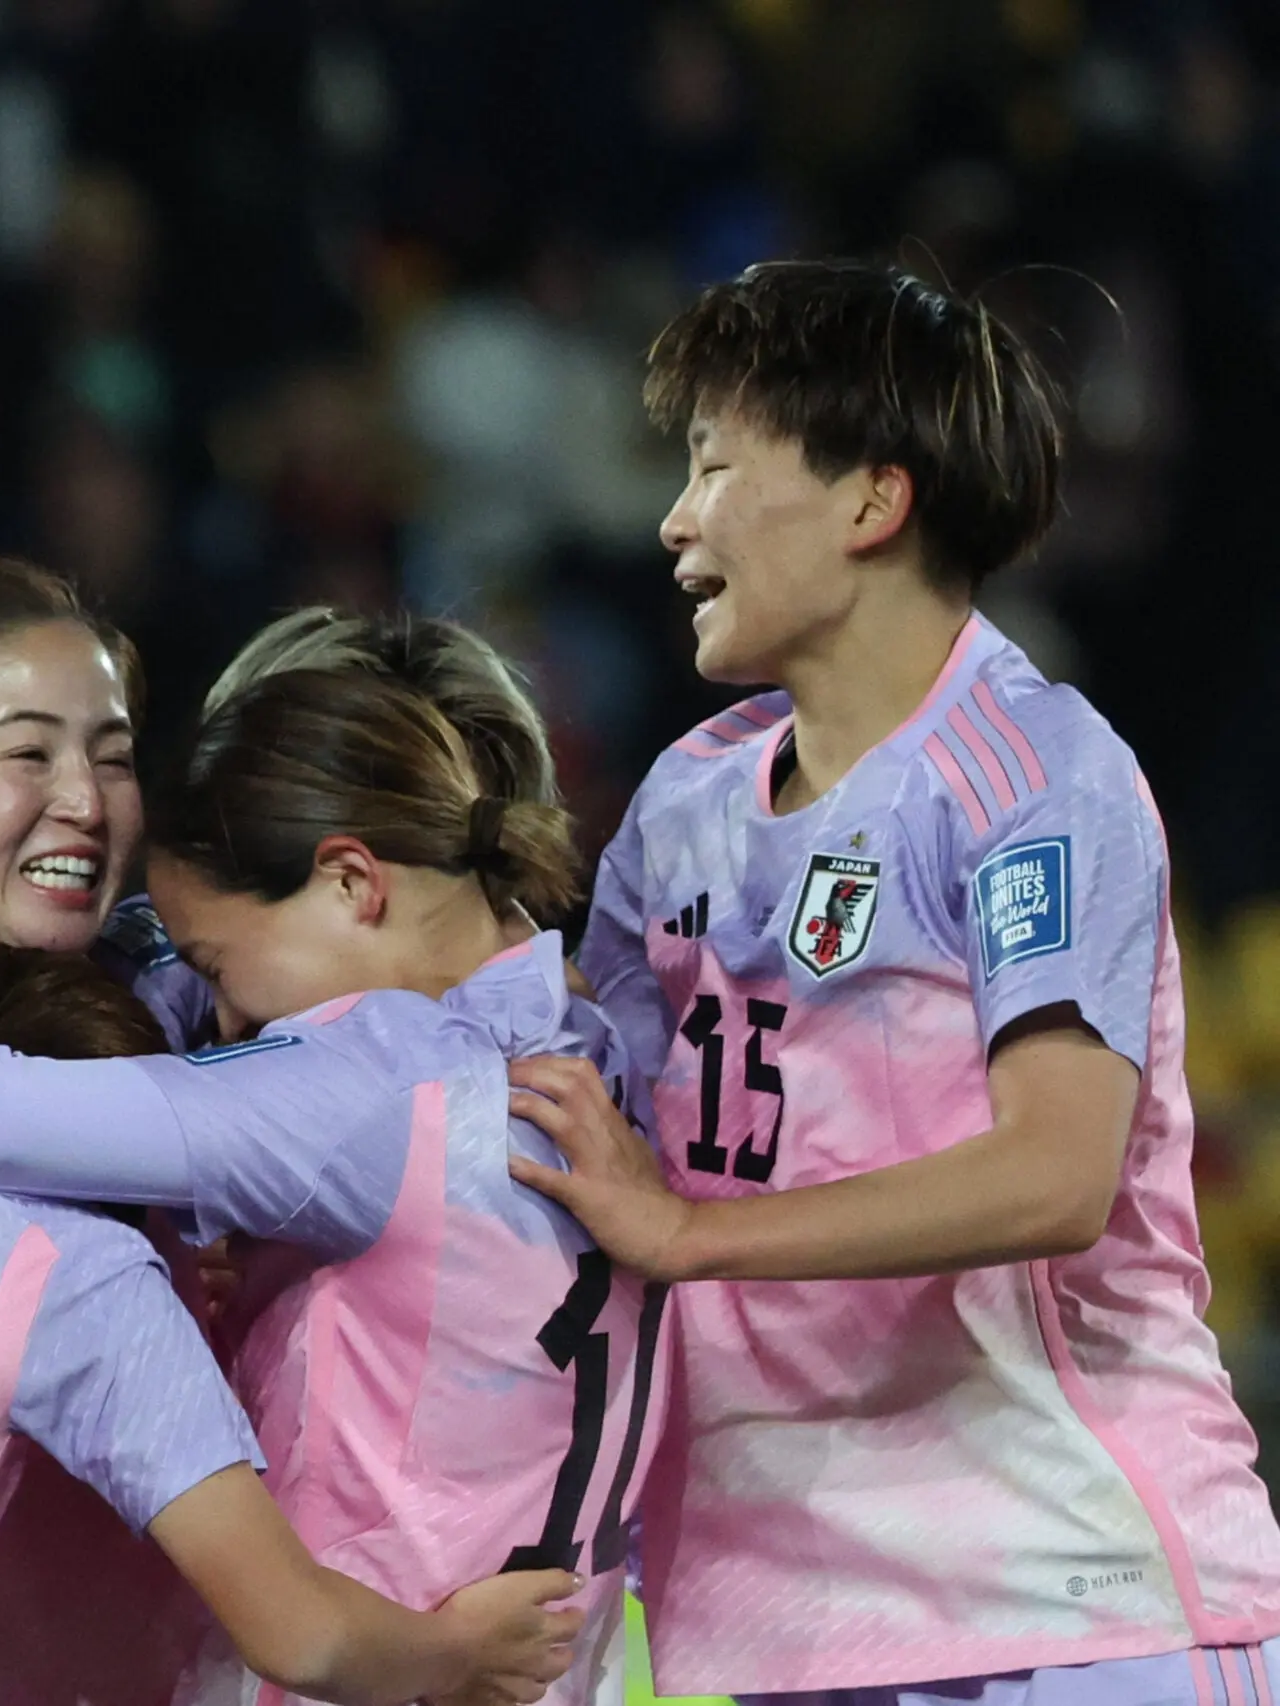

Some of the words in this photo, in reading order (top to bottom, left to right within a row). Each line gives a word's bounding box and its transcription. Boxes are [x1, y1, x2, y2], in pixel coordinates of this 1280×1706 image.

[828, 860, 872, 874] JAPAN
[990, 859, 1045, 892] FOOTBALL
[991, 875, 1045, 914] UNITES
[1007, 895, 1050, 925] World
[680, 994, 789, 1184] 15
